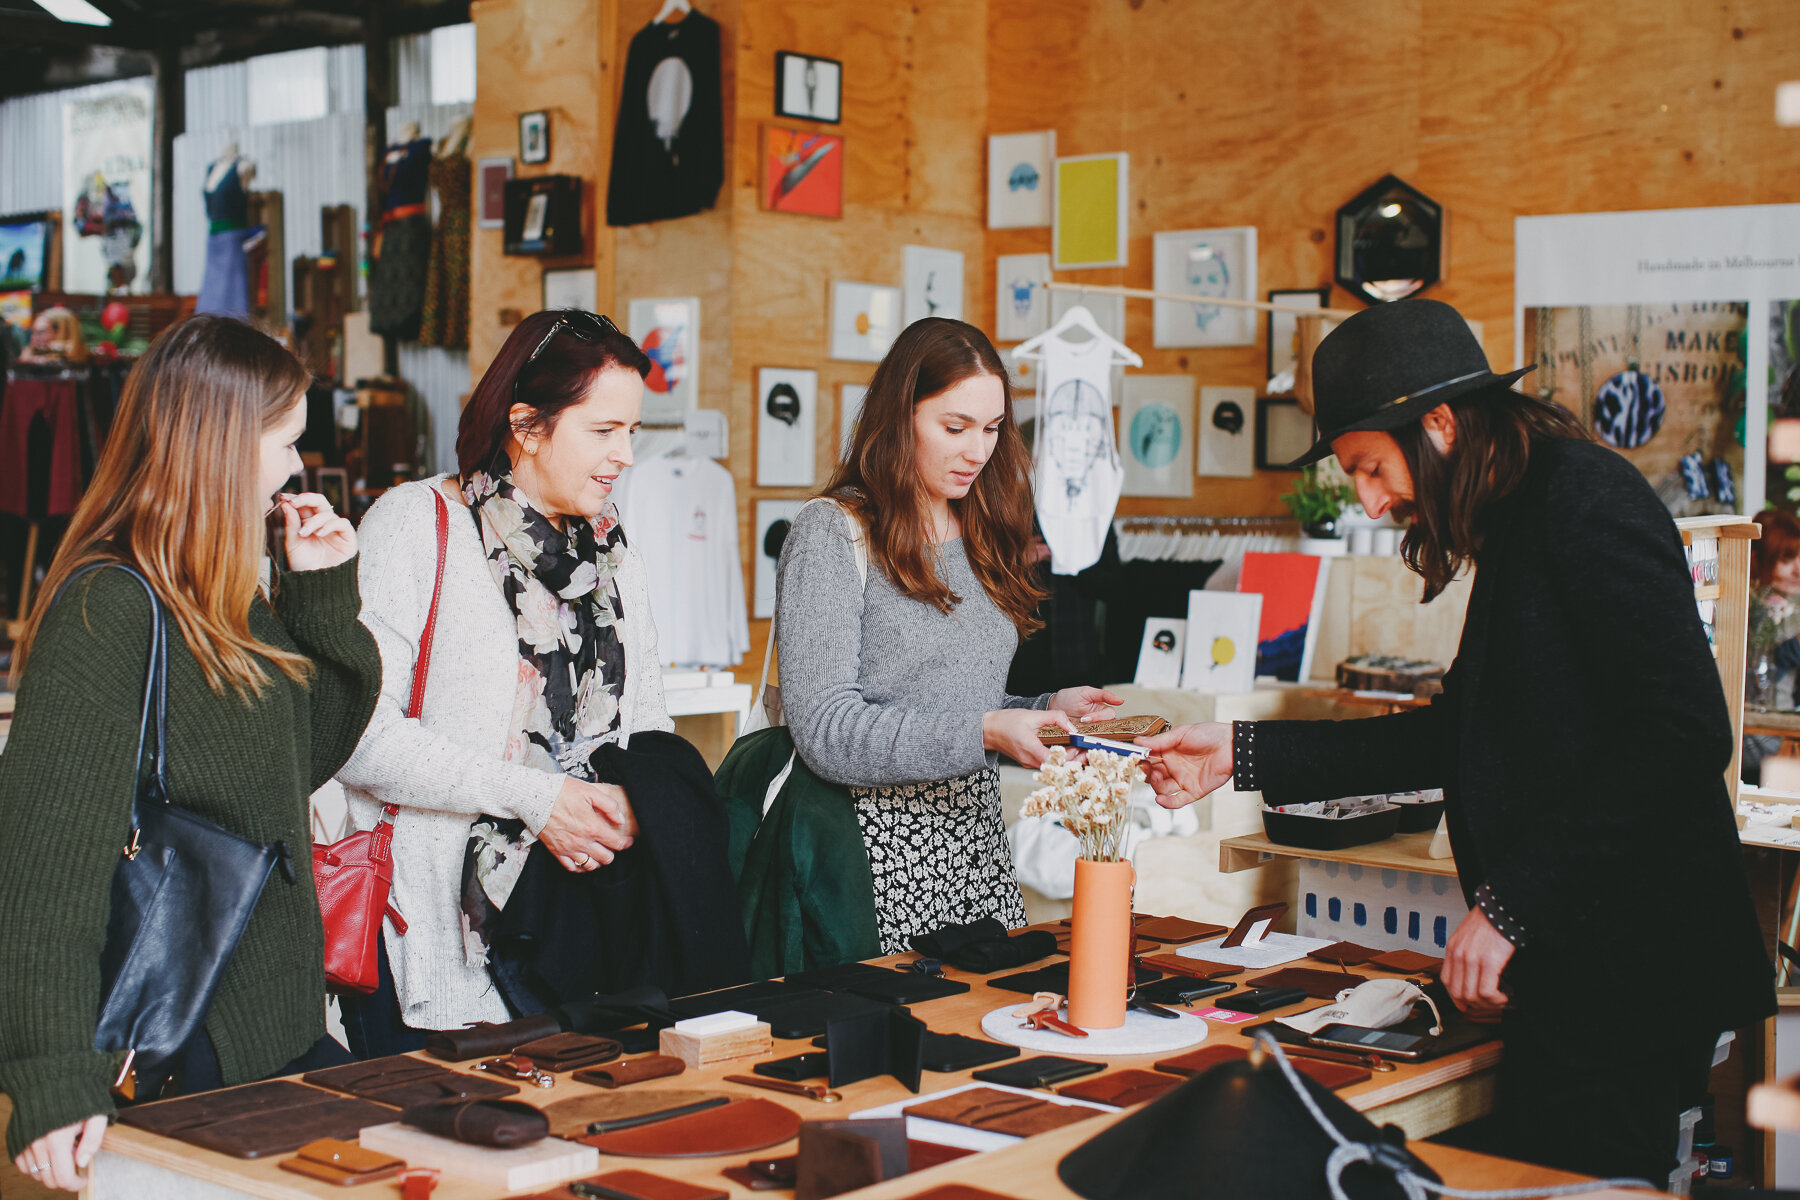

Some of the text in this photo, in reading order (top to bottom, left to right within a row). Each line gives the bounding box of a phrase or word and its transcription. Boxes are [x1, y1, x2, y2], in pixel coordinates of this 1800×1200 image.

[1637, 257, 1704, 274] Handmade
[1708, 258, 1721, 272] in
[1725, 254, 1795, 270] Melbourne
